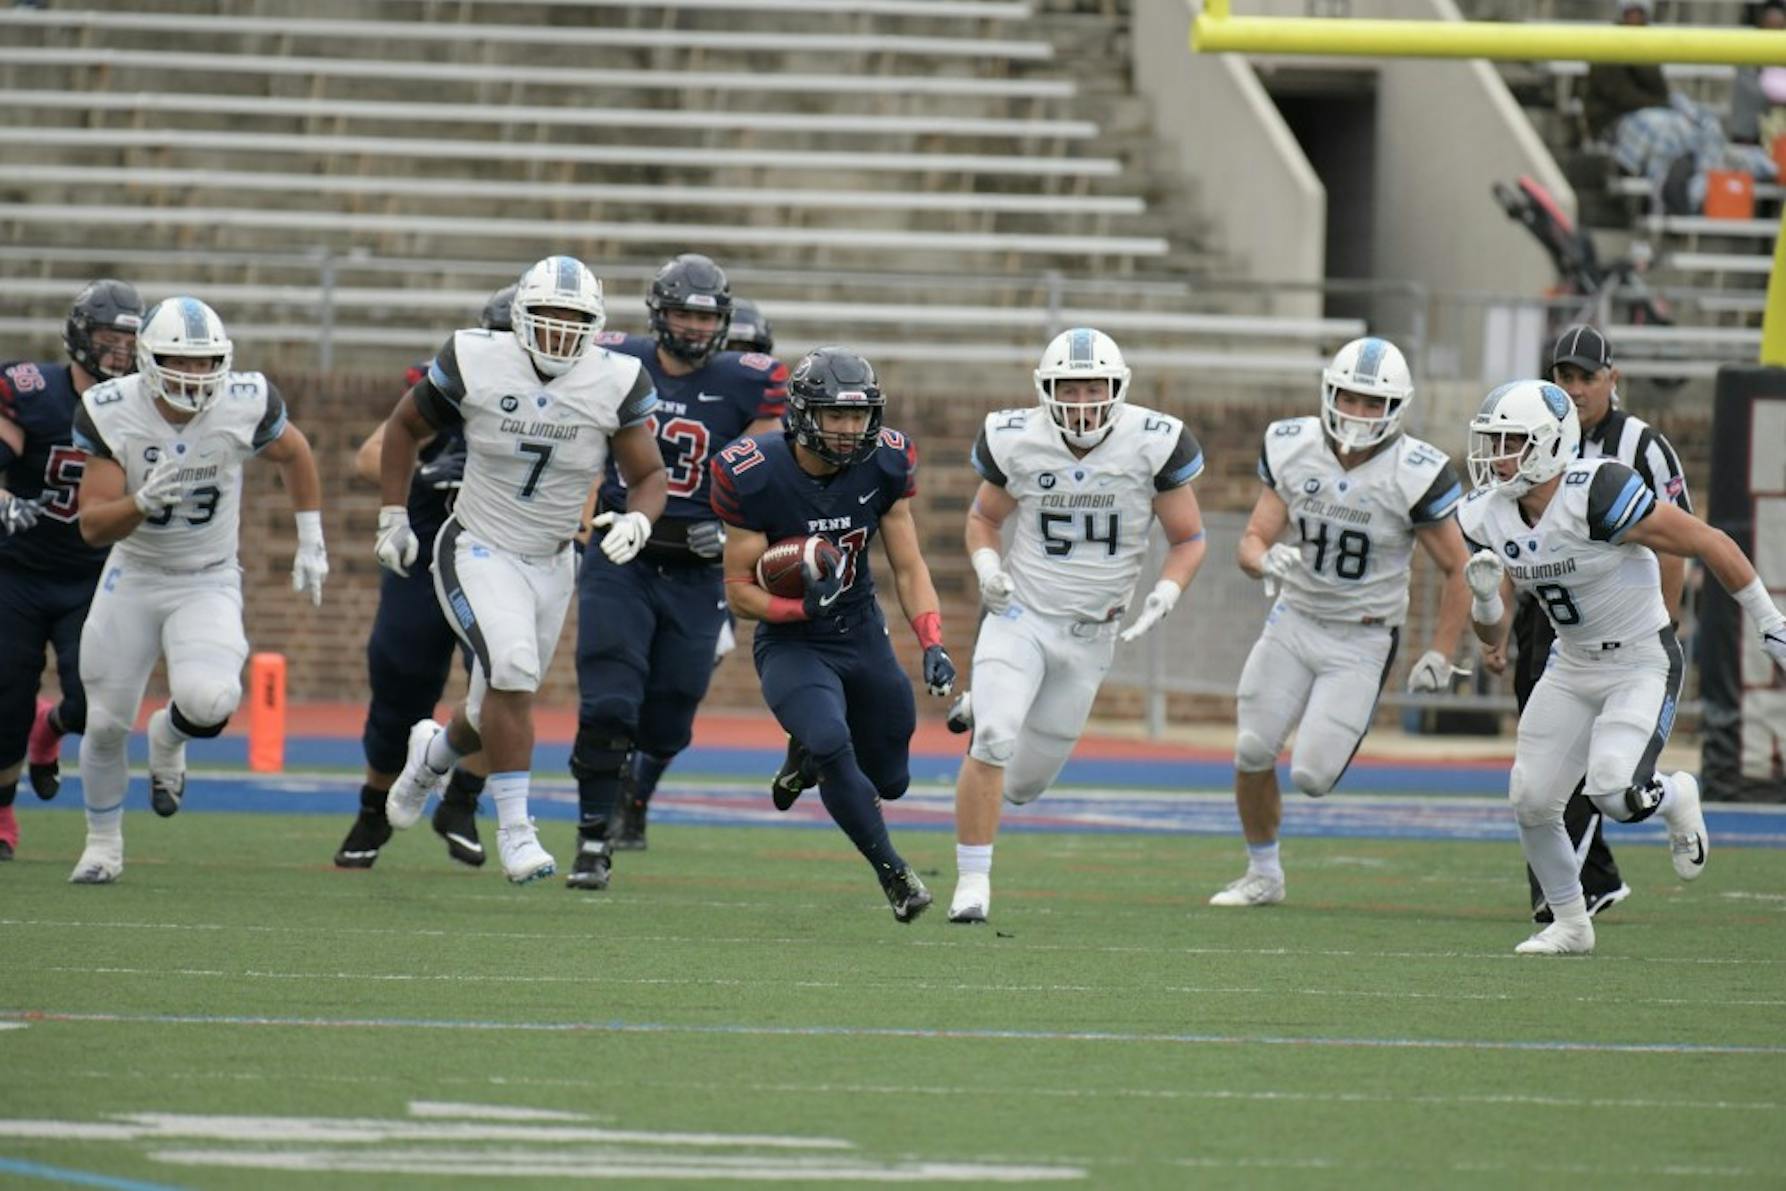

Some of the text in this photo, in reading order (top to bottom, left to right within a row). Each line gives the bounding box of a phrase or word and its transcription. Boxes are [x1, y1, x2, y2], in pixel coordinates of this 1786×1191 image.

[499, 418, 580, 441] COLUMBIA
[654, 399, 688, 416] ENN
[515, 441, 556, 500] 7
[646, 414, 710, 498] 3
[720, 437, 766, 475] 21
[41, 445, 92, 523] 5
[1040, 493, 1116, 509] COLUMBIA
[807, 516, 852, 532] PENN
[1038, 510, 1121, 558] 54
[1303, 499, 1373, 526] COLUMBIA
[838, 525, 869, 593] 1
[1298, 517, 1371, 581] 48
[1535, 582, 1581, 626] 8
